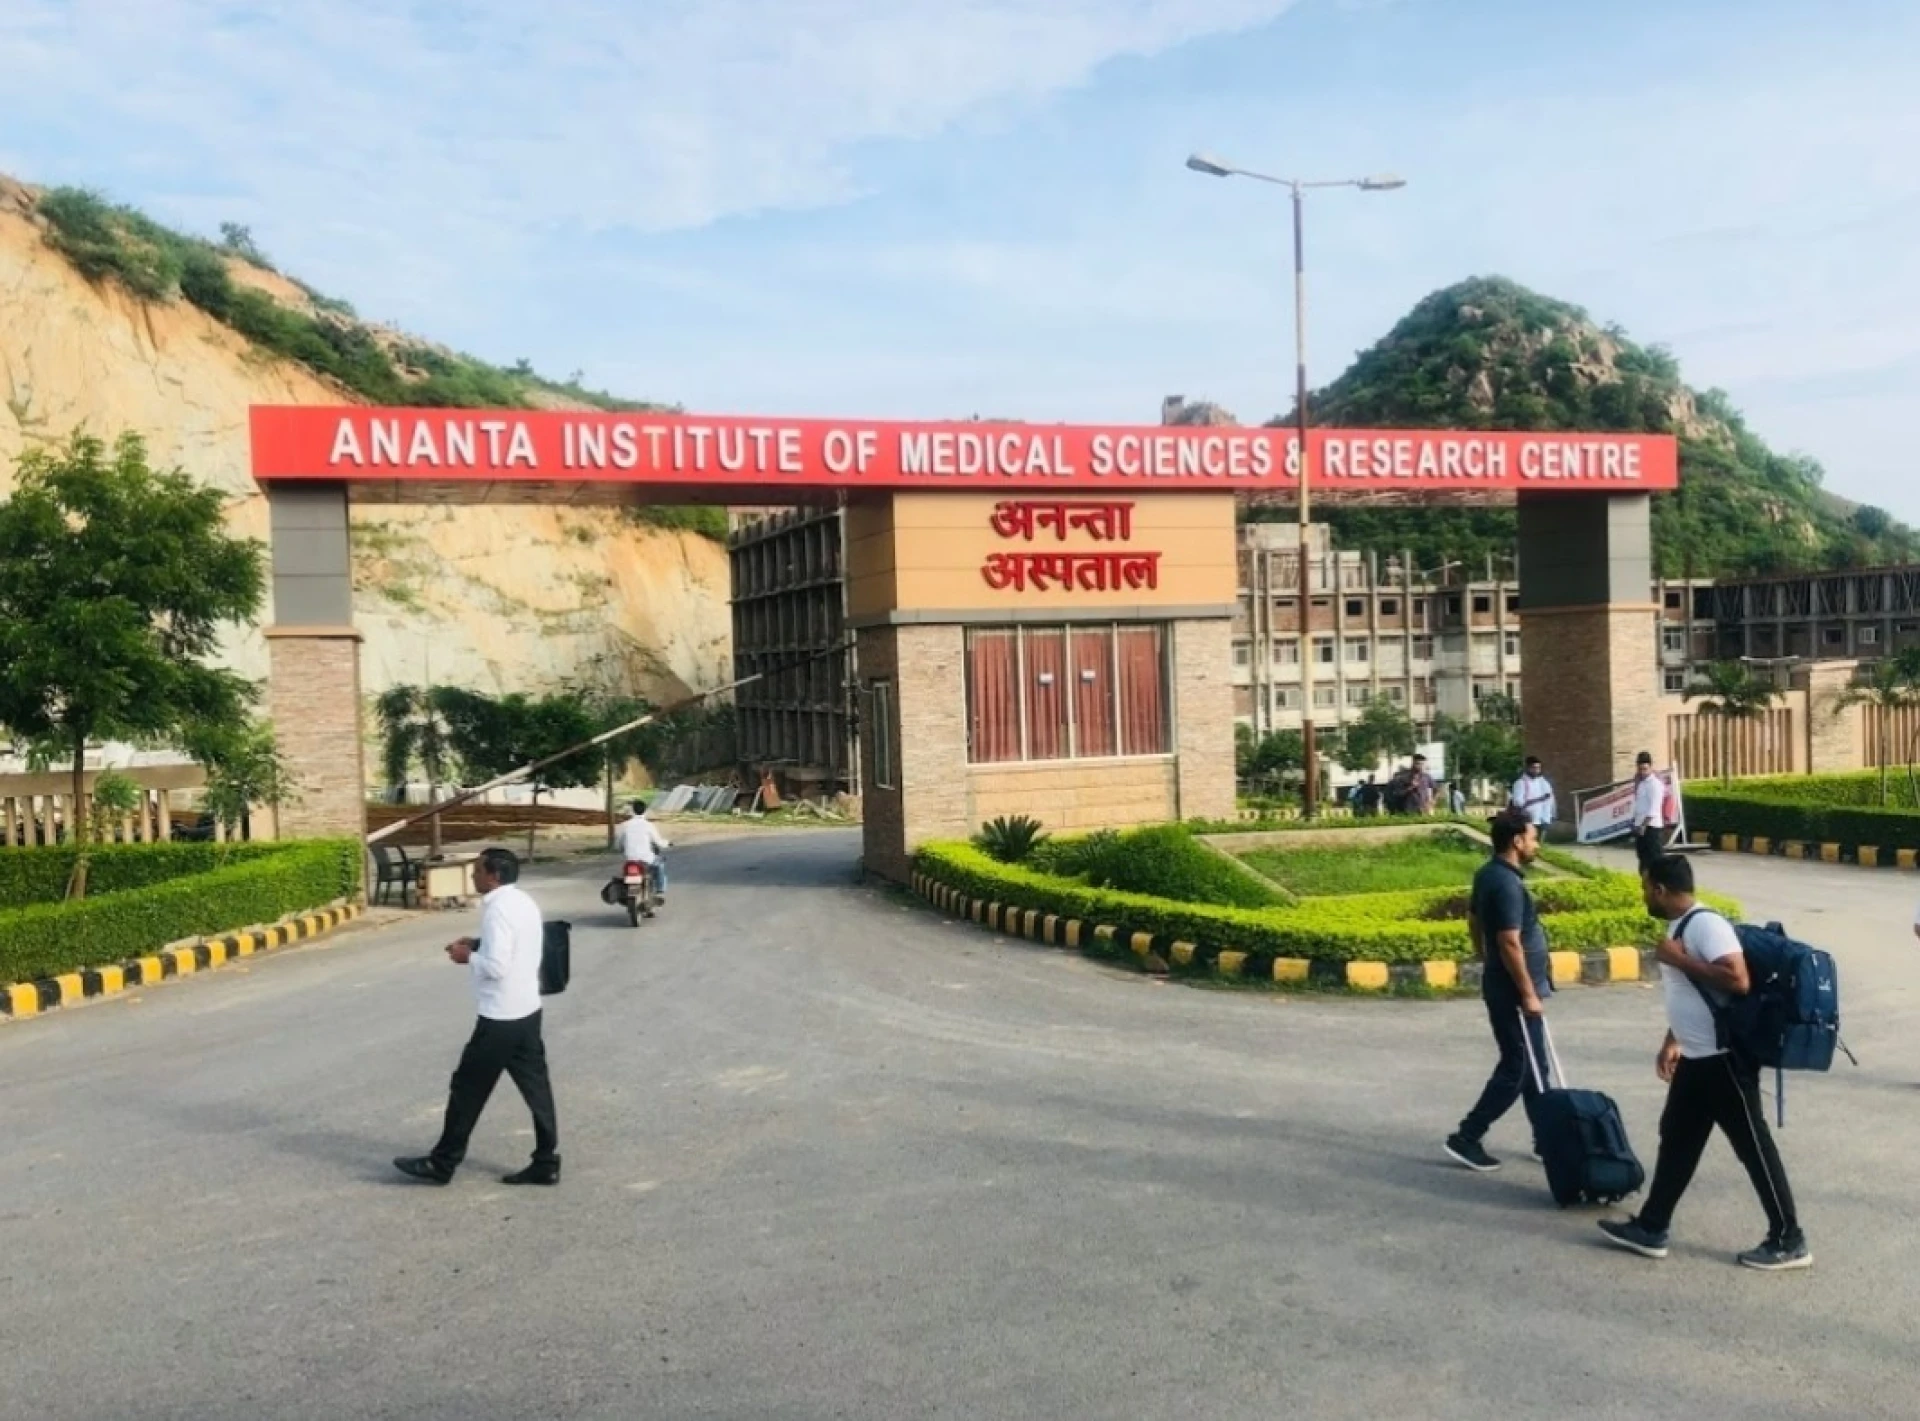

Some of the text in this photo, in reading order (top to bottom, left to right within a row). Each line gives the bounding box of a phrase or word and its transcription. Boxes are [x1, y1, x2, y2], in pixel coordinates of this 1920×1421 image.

[330, 417, 538, 468] ANANTA
[563, 423, 803, 472] INSTITUTE
[824, 430, 878, 473] OF
[900, 432, 1074, 474] MEDICAL
[1091, 436, 1272, 476] SCIENCES
[1324, 438, 1507, 476] RESEARCH
[1520, 442, 1641, 479] CENTRE
[989, 501, 1135, 541] अनन्ता
[981, 551, 1162, 592] अस्पताल
